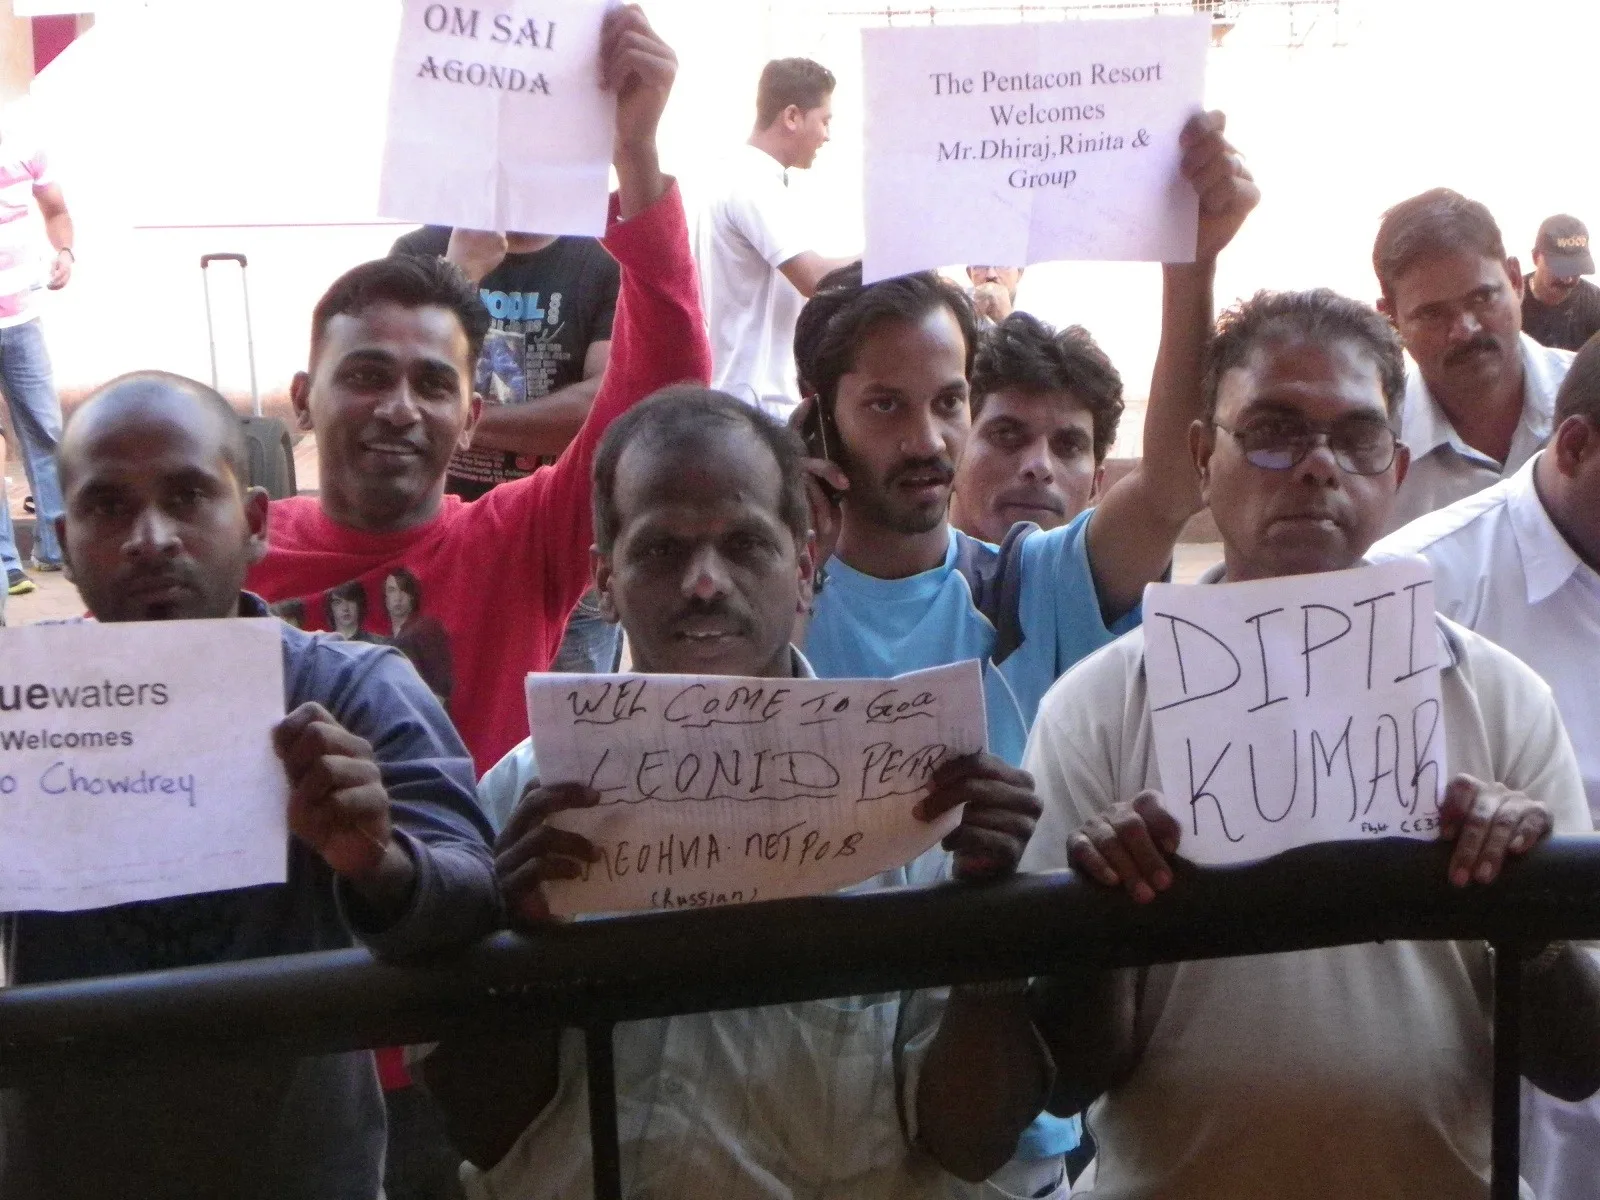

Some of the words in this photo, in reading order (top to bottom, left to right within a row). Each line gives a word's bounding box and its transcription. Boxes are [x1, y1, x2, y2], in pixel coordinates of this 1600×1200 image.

[423, 3, 481, 40] OM
[490, 14, 557, 50] SAI
[416, 55, 552, 96] AGONDA
[929, 73, 973, 96] The
[981, 67, 1082, 93] Pentacon
[1090, 60, 1163, 85] Resort
[989, 102, 1106, 127] Welcomes
[1130, 128, 1151, 149] &
[1007, 169, 1077, 190] Group
[1151, 580, 1437, 713] DIPTI
[1, 729, 135, 751] Welcomes
[39, 761, 196, 808] Chowdrey
[588, 749, 841, 799] LEONID
[1185, 699, 1442, 843] KUMAR
